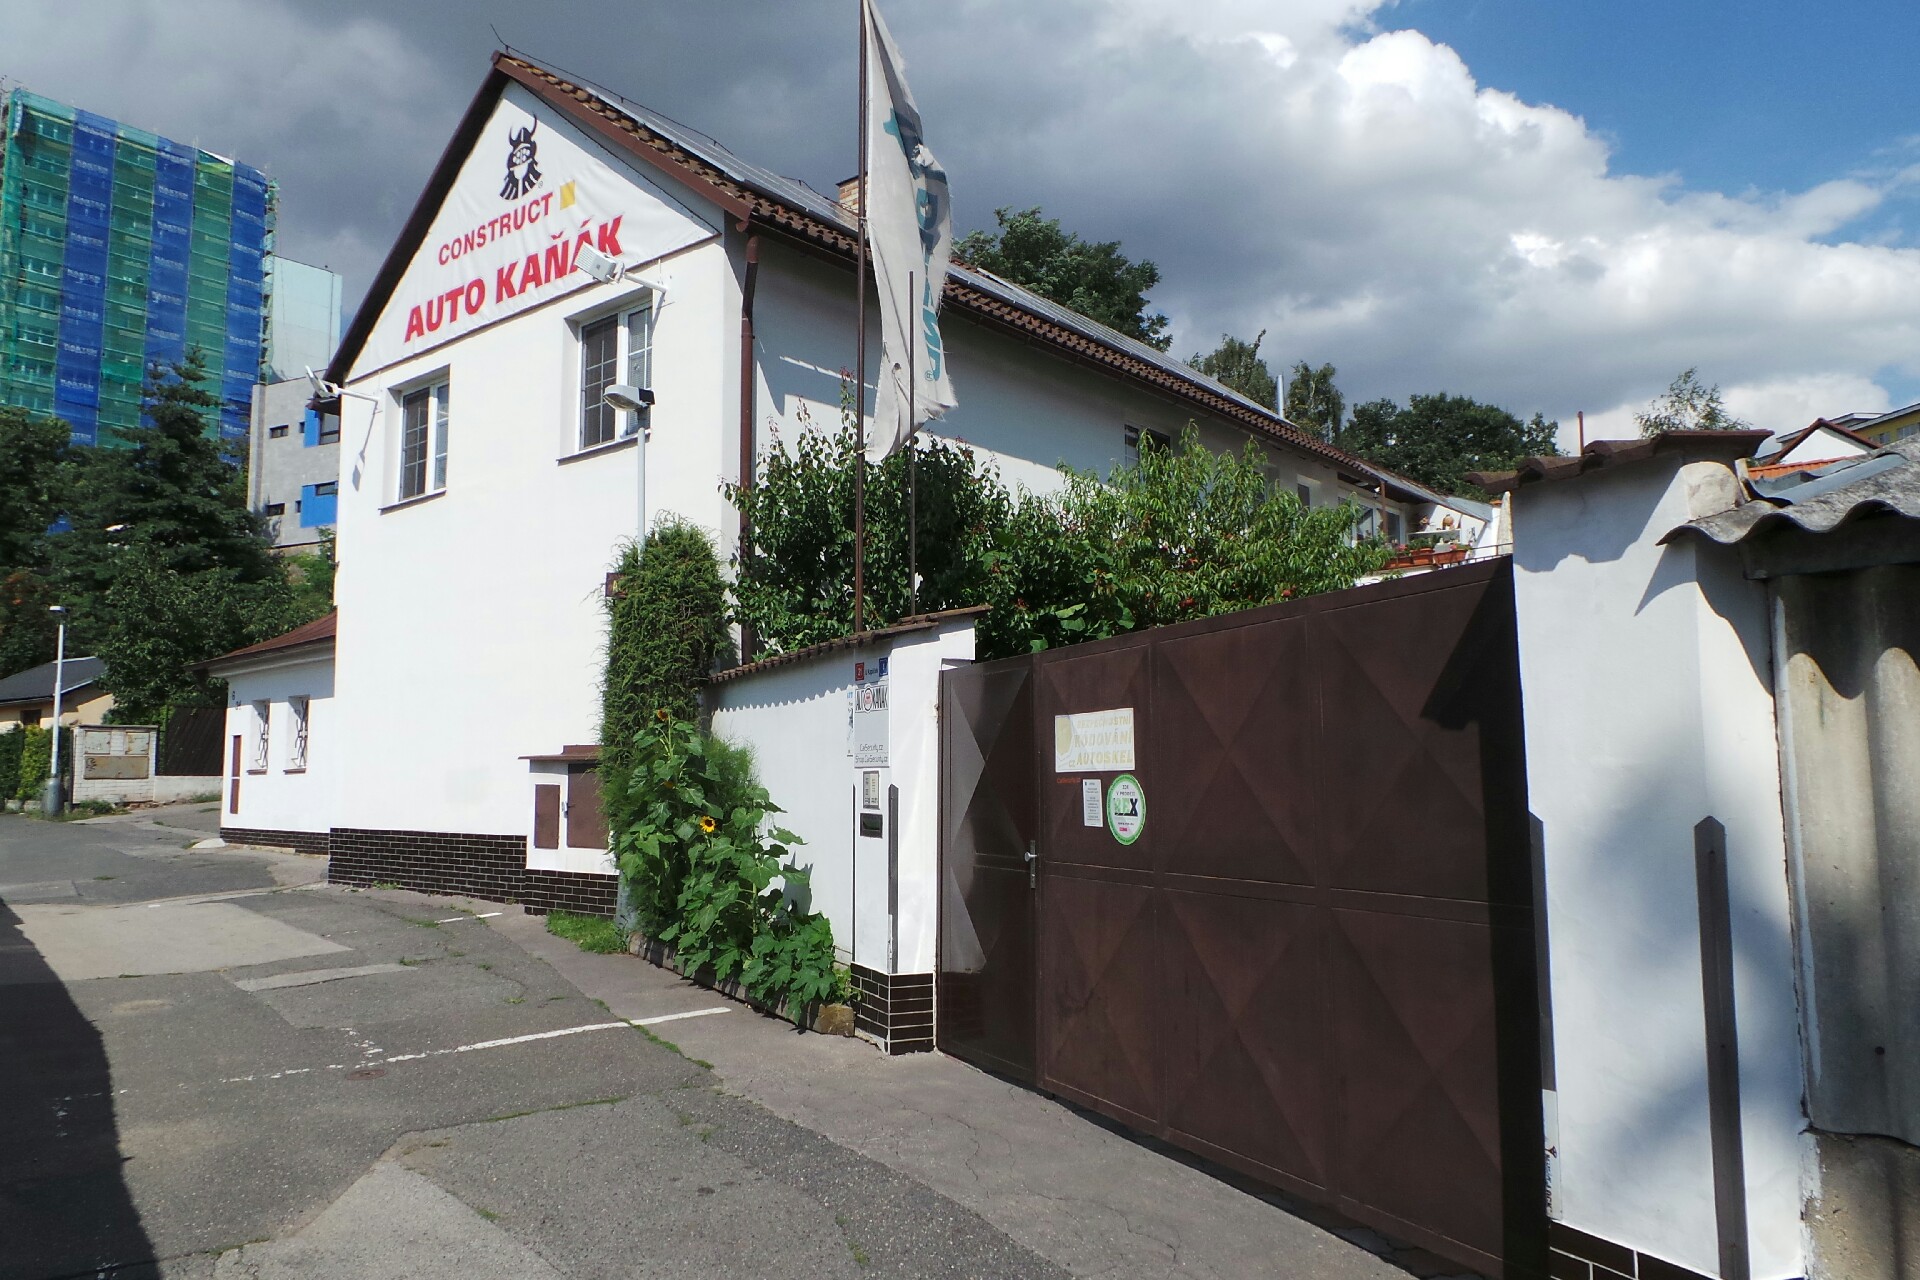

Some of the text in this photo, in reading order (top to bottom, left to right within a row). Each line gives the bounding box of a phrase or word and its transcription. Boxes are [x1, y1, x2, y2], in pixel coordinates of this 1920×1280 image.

[404, 214, 625, 343] AUTO KAŇÁK
[438, 192, 553, 266] CONSTRUCT
